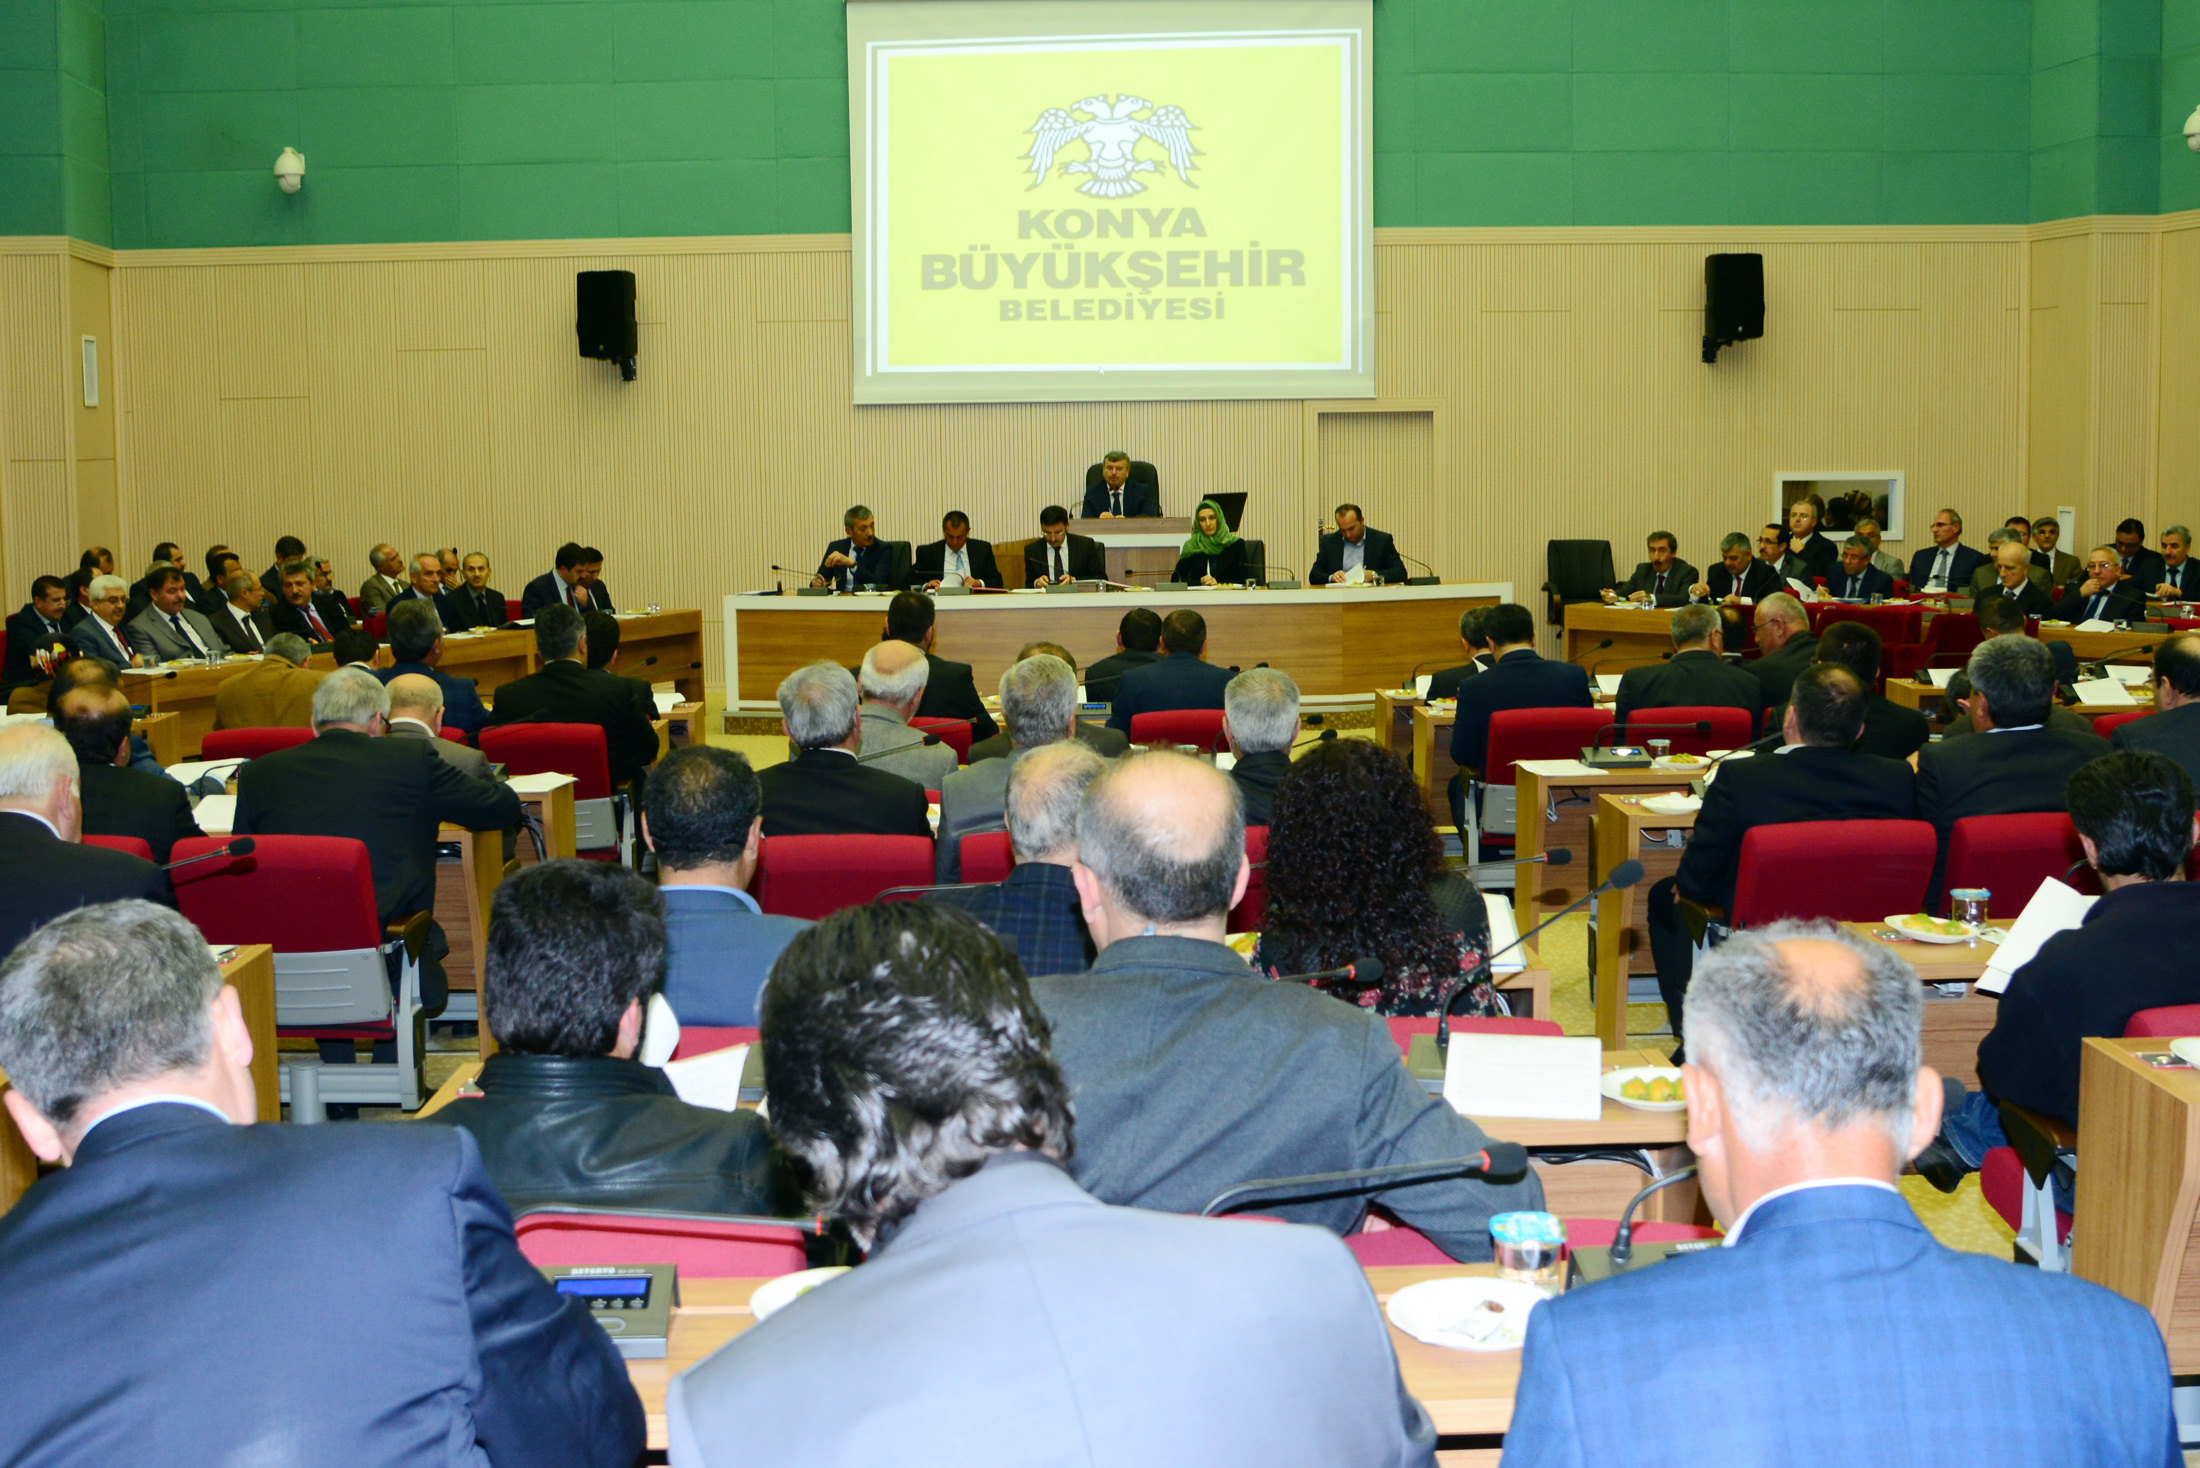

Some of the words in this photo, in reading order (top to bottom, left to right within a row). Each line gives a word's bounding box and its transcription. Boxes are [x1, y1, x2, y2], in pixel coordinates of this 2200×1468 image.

[1018, 207, 1207, 240] KONYA
[921, 241, 1306, 294] BÜYÜKŞEHİR
[999, 292, 1225, 322] BELEDİYESİ
